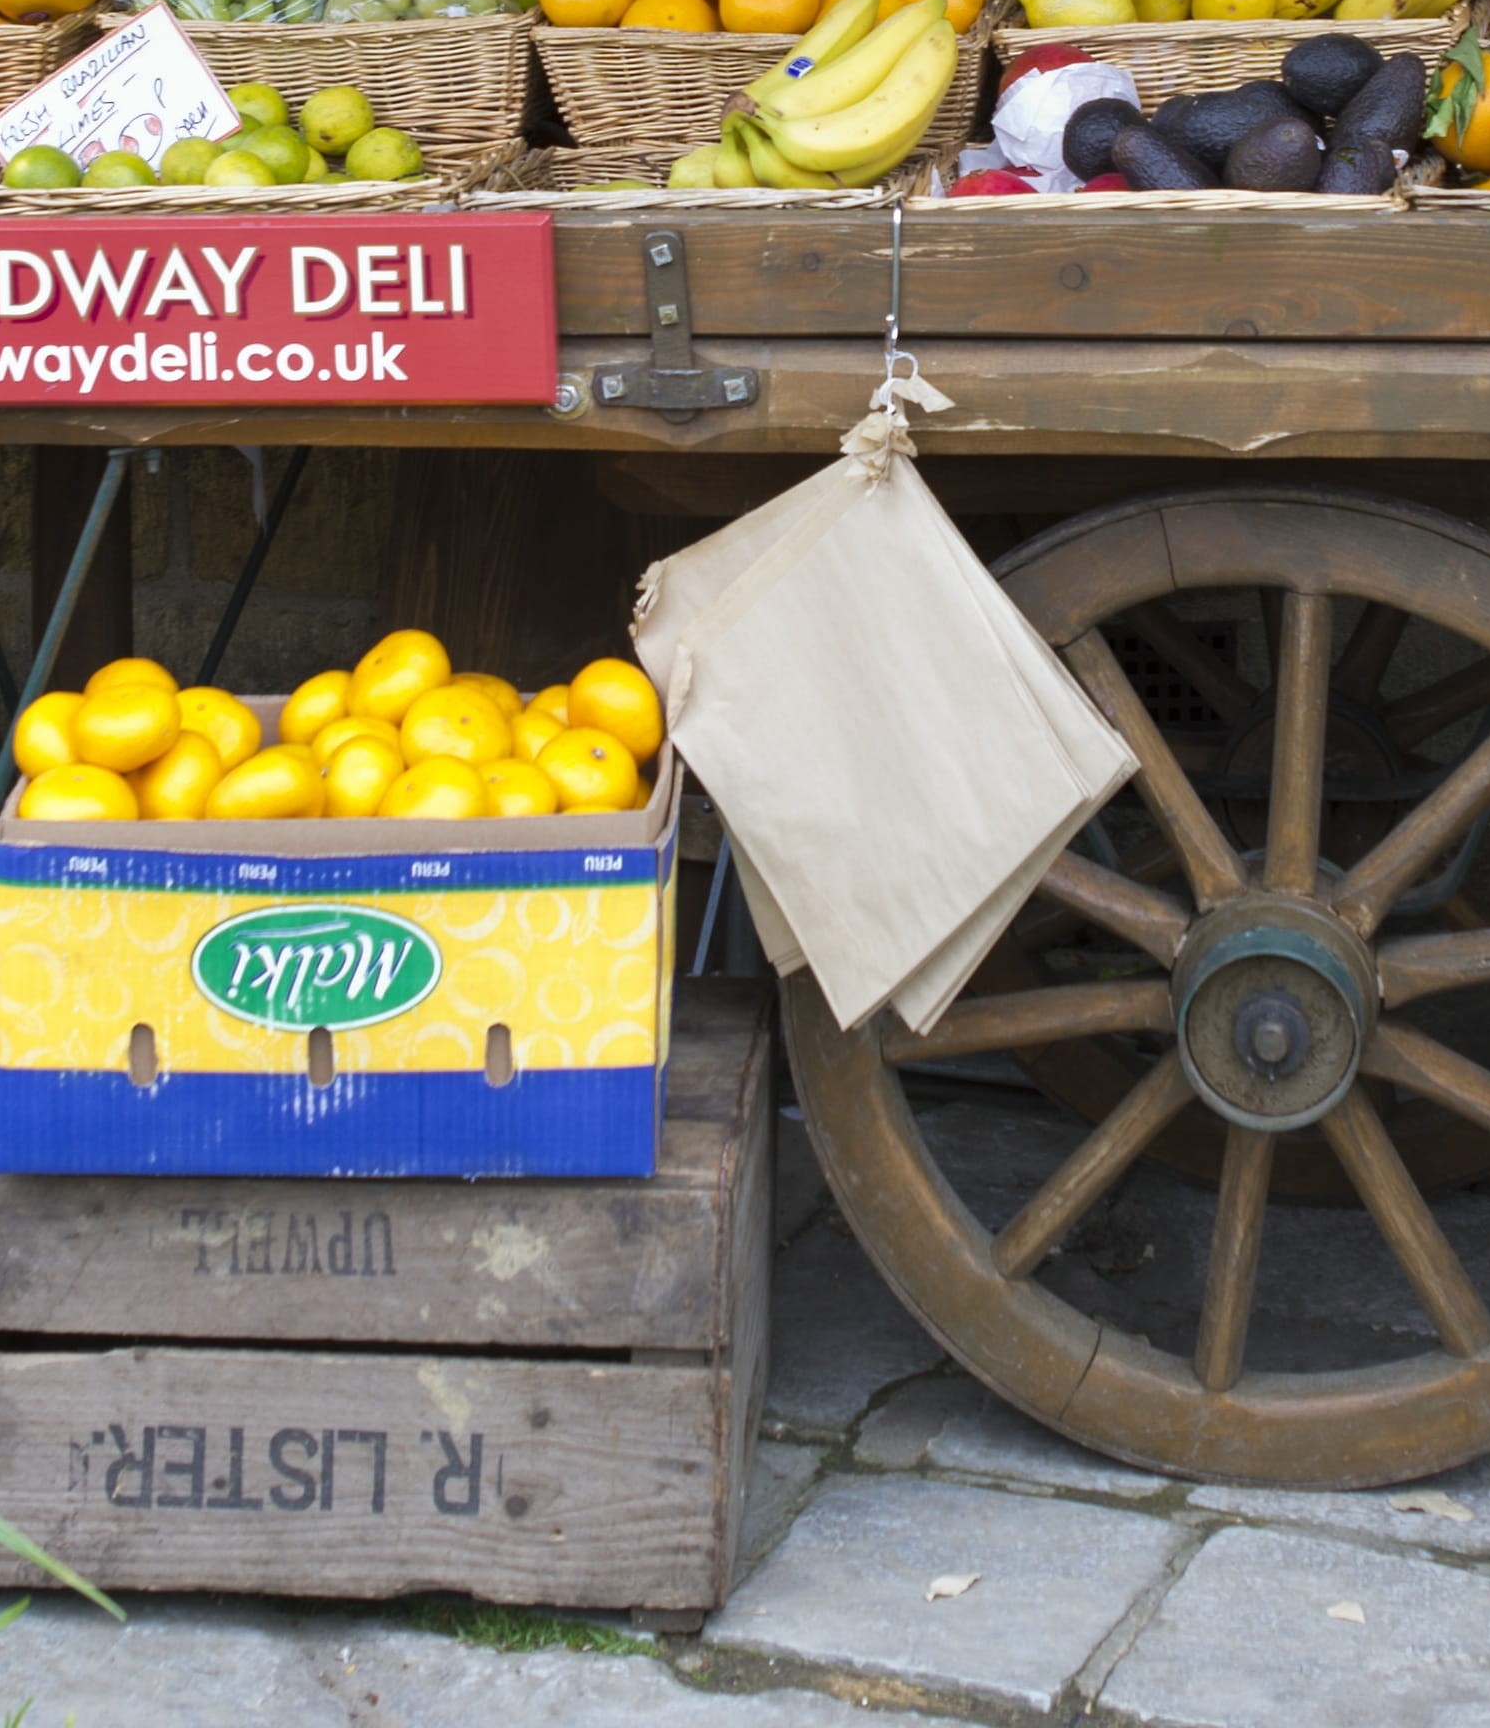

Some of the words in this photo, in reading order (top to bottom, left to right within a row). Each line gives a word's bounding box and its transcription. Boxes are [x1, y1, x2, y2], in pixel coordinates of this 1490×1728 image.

[290, 243, 468, 315] DELI
[68, 856, 108, 873] PERU
[238, 862, 277, 881] PERU
[411, 860, 451, 878] PERU
[583, 854, 623, 873] PERU
[227, 927, 414, 1009] Malki
